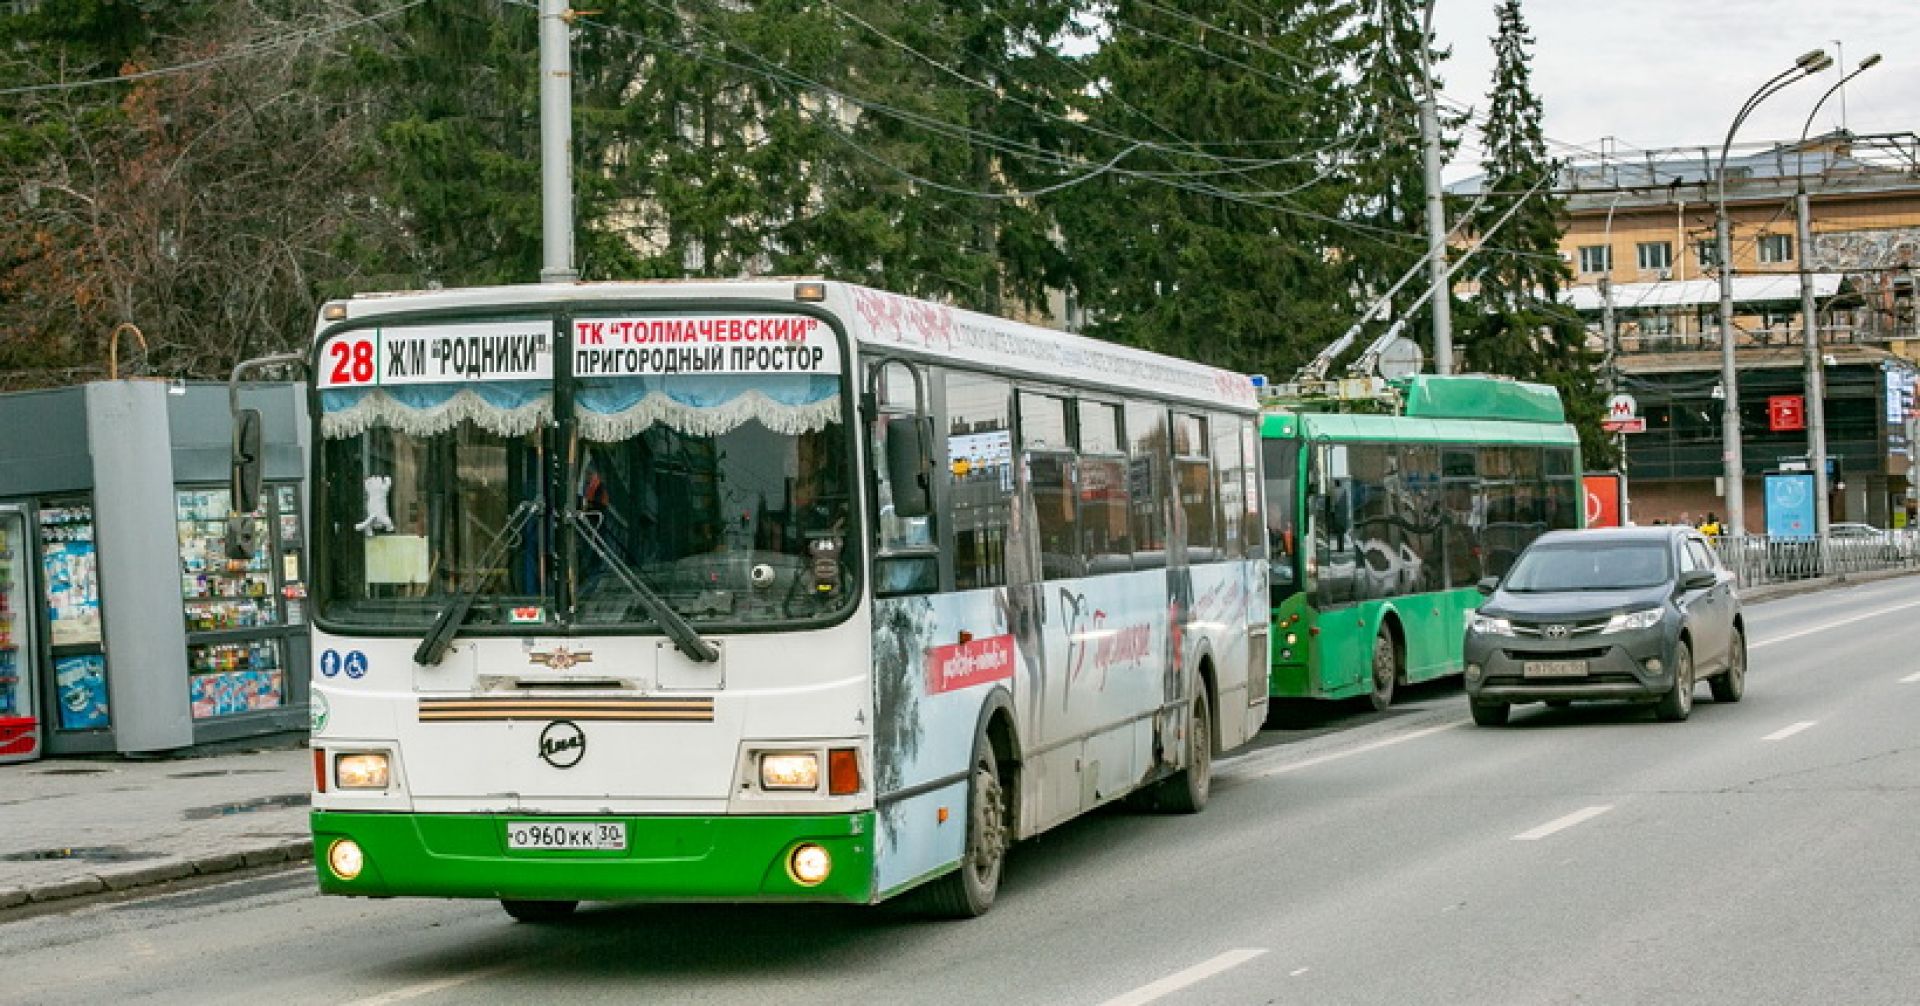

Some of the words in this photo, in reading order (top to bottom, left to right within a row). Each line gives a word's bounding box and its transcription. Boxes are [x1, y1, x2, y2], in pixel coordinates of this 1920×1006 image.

[577, 321, 605, 344] ТК
[330, 340, 374, 385] 28
[576, 344, 725, 374] ПРИГОРОДНЫЙ
[730, 345, 823, 371] ПРОСТОР
[599, 825, 619, 841] 30
